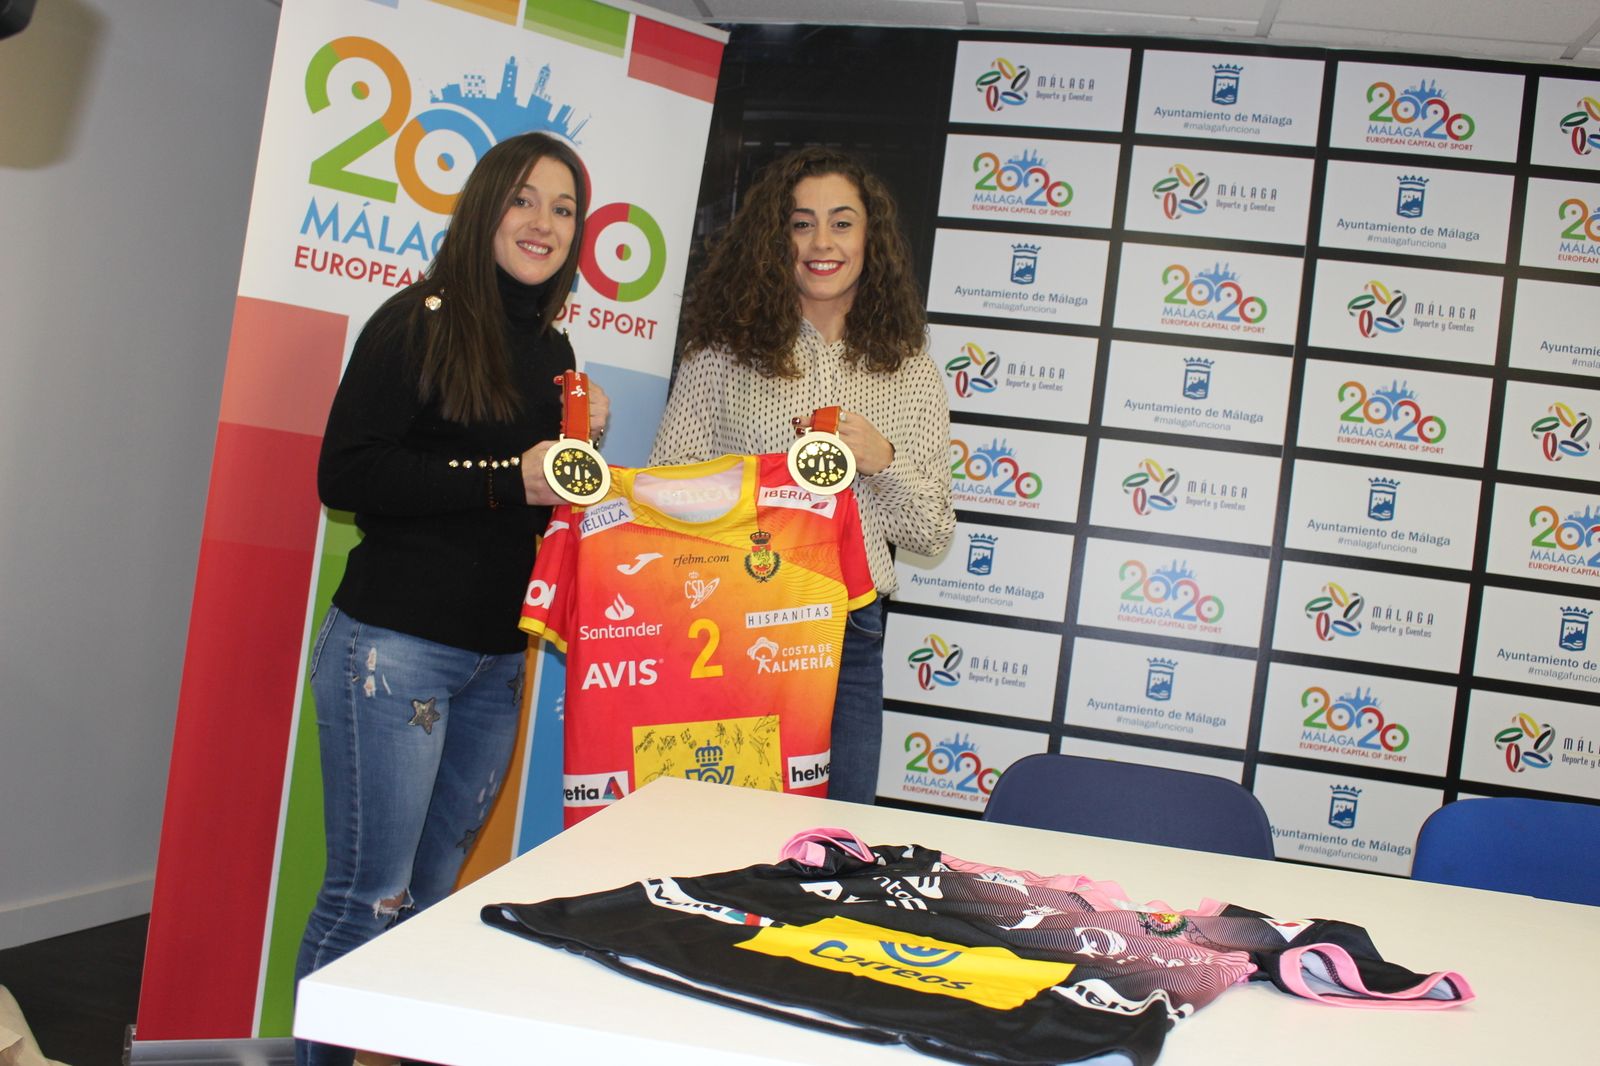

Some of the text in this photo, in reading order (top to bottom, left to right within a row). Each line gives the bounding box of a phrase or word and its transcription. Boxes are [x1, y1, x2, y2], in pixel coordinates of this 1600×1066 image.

[1037, 72, 1095, 90] MÁLAGA
[1035, 90, 1060, 101] Deporte
[1153, 106, 1292, 127] Ayuntamiento de Málaga
[1367, 82, 1475, 139] 2020
[1183, 121, 1260, 136] #malagafunciona
[1366, 135, 1473, 150] EUROPEAN CAPITAL OF SPORT
[304, 36, 667, 302] 200
[973, 152, 1073, 207] 2020
[1217, 180, 1278, 200] MÁLAGA
[971, 203, 1009, 213] EUROPEAN
[1010, 206, 1037, 215] CAPITAL
[1050, 209, 1071, 217] SPORT
[1215, 199, 1240, 210] Deporte
[1336, 218, 1480, 242] Ayuntamiento de Málaga
[1367, 234, 1447, 250] #malagafunciona
[1558, 253, 1600, 264] EUROPEAN
[954, 284, 1088, 308] Ayuntamiento de Málaga
[1162, 264, 1267, 322] 2020
[982, 300, 1057, 316] #malagafunciona
[1414, 298, 1477, 320] MÁLAGA
[588, 309, 658, 340] SPORT
[1160, 317, 1265, 334] EUROPEAN CAPITAL OF SPORT
[1412, 318, 1438, 330] Deporte
[1007, 359, 1065, 379] MÁLAGA
[1005, 378, 1029, 389] Deporte
[1123, 398, 1264, 424] Ayuntamiento de Málaga
[1338, 382, 1446, 442] 2020
[1153, 415, 1231, 432] #malagafunciona
[1336, 435, 1444, 454] EUROPEAN CAPITAL OF SPORT
[764, 490, 812, 502] IBERIA
[951, 480, 993, 495] ÁLAGA
[1187, 477, 1248, 498] MÁLAGA
[952, 492, 1040, 510] OPEAN CAPITAL OF SPORT
[1185, 496, 1211, 508] Deporte
[1306, 519, 1451, 547] Ayuntamiento de Málaga
[1337, 536, 1418, 555] #malagafunciona
[673, 554, 730, 567] rfebm.com
[1528, 560, 1570, 573] EUROPEAN
[910, 573, 1044, 601] Ayuntamiento de Málaga
[939, 590, 1013, 608] #malagafunciona
[748, 606, 830, 626] HISPANITAS
[1371, 602, 1435, 625] MÁLAGA
[580, 622, 662, 640] Santander
[1370, 622, 1396, 634] Deporte
[688, 618, 724, 679] 2
[782, 643, 832, 656] COSTA DE
[772, 653, 834, 672] ALMERÍA
[970, 653, 1028, 676] MÁLAGA
[1496, 648, 1598, 670] Ayuntamiento de
[582, 658, 658, 690] AVIS
[968, 672, 992, 684] Deporte
[1086, 697, 1226, 728] Ayuntamiento de Málaga
[1301, 687, 1409, 751] 2020
[1116, 715, 1194, 735] #malagafunciona
[1299, 741, 1407, 763] EUROPEAN CAPITAL OF SPORT
[1563, 734, 1600, 754] MÁL
[904, 732, 1001, 794] 2020
[1561, 754, 1588, 767] Deporte
[902, 784, 940, 796] EUROPEAN
[940, 790, 968, 801] CAPITAL
[969, 794, 979, 802] OF
[1298, 843, 1378, 864] #malagafunciona
[1351, 837, 1366, 848] de
[1368, 839, 1412, 857] Málaga
[809, 940, 974, 990] Correos
